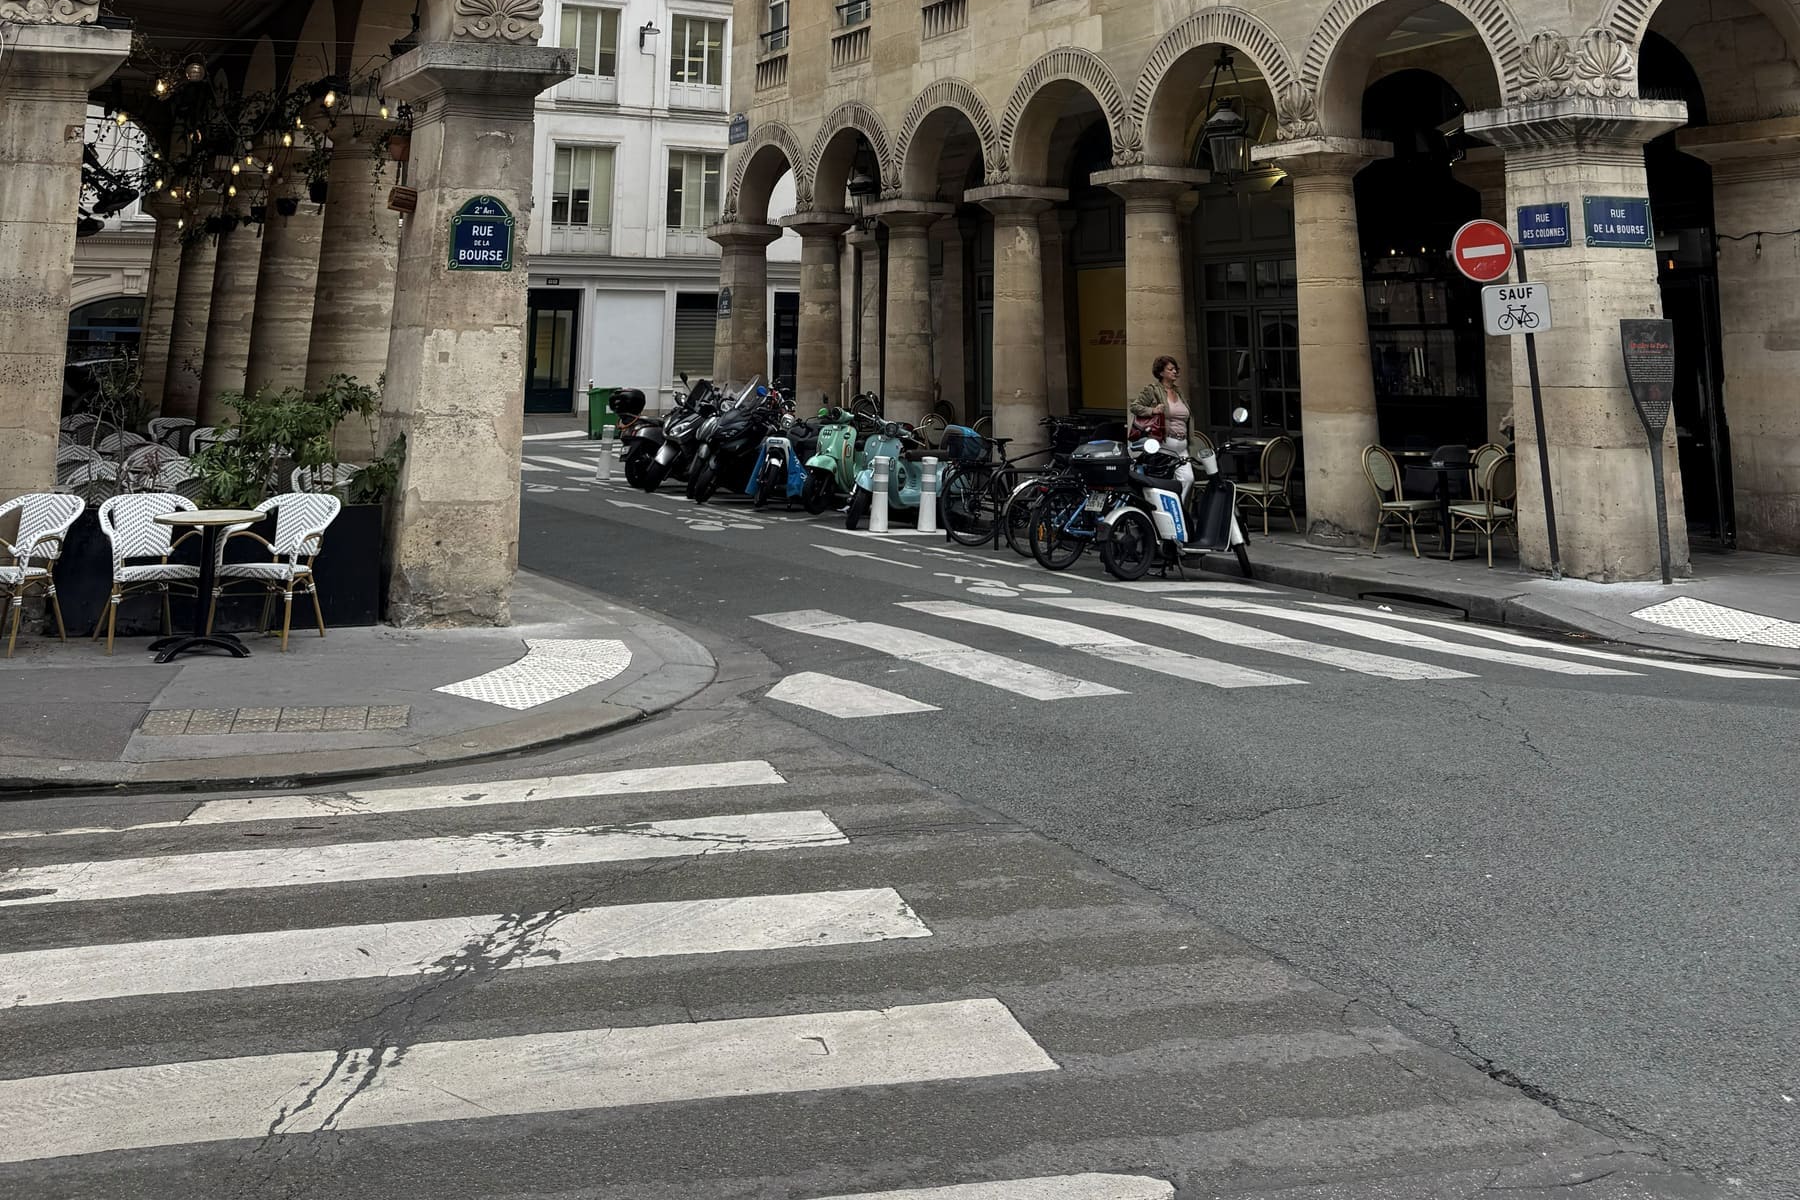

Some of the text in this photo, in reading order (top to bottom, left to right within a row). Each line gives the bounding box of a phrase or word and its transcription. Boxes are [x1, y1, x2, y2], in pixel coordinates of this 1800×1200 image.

[1535, 213, 1550, 223] RUE
[1610, 209, 1626, 218] RUE
[472, 225, 494, 237] RUE
[1523, 227, 1565, 239] DES COLONNES
[1593, 223, 1645, 235] DE LA BOURSE
[459, 249, 503, 261] BOURSE
[1499, 287, 1533, 300] SAUF
